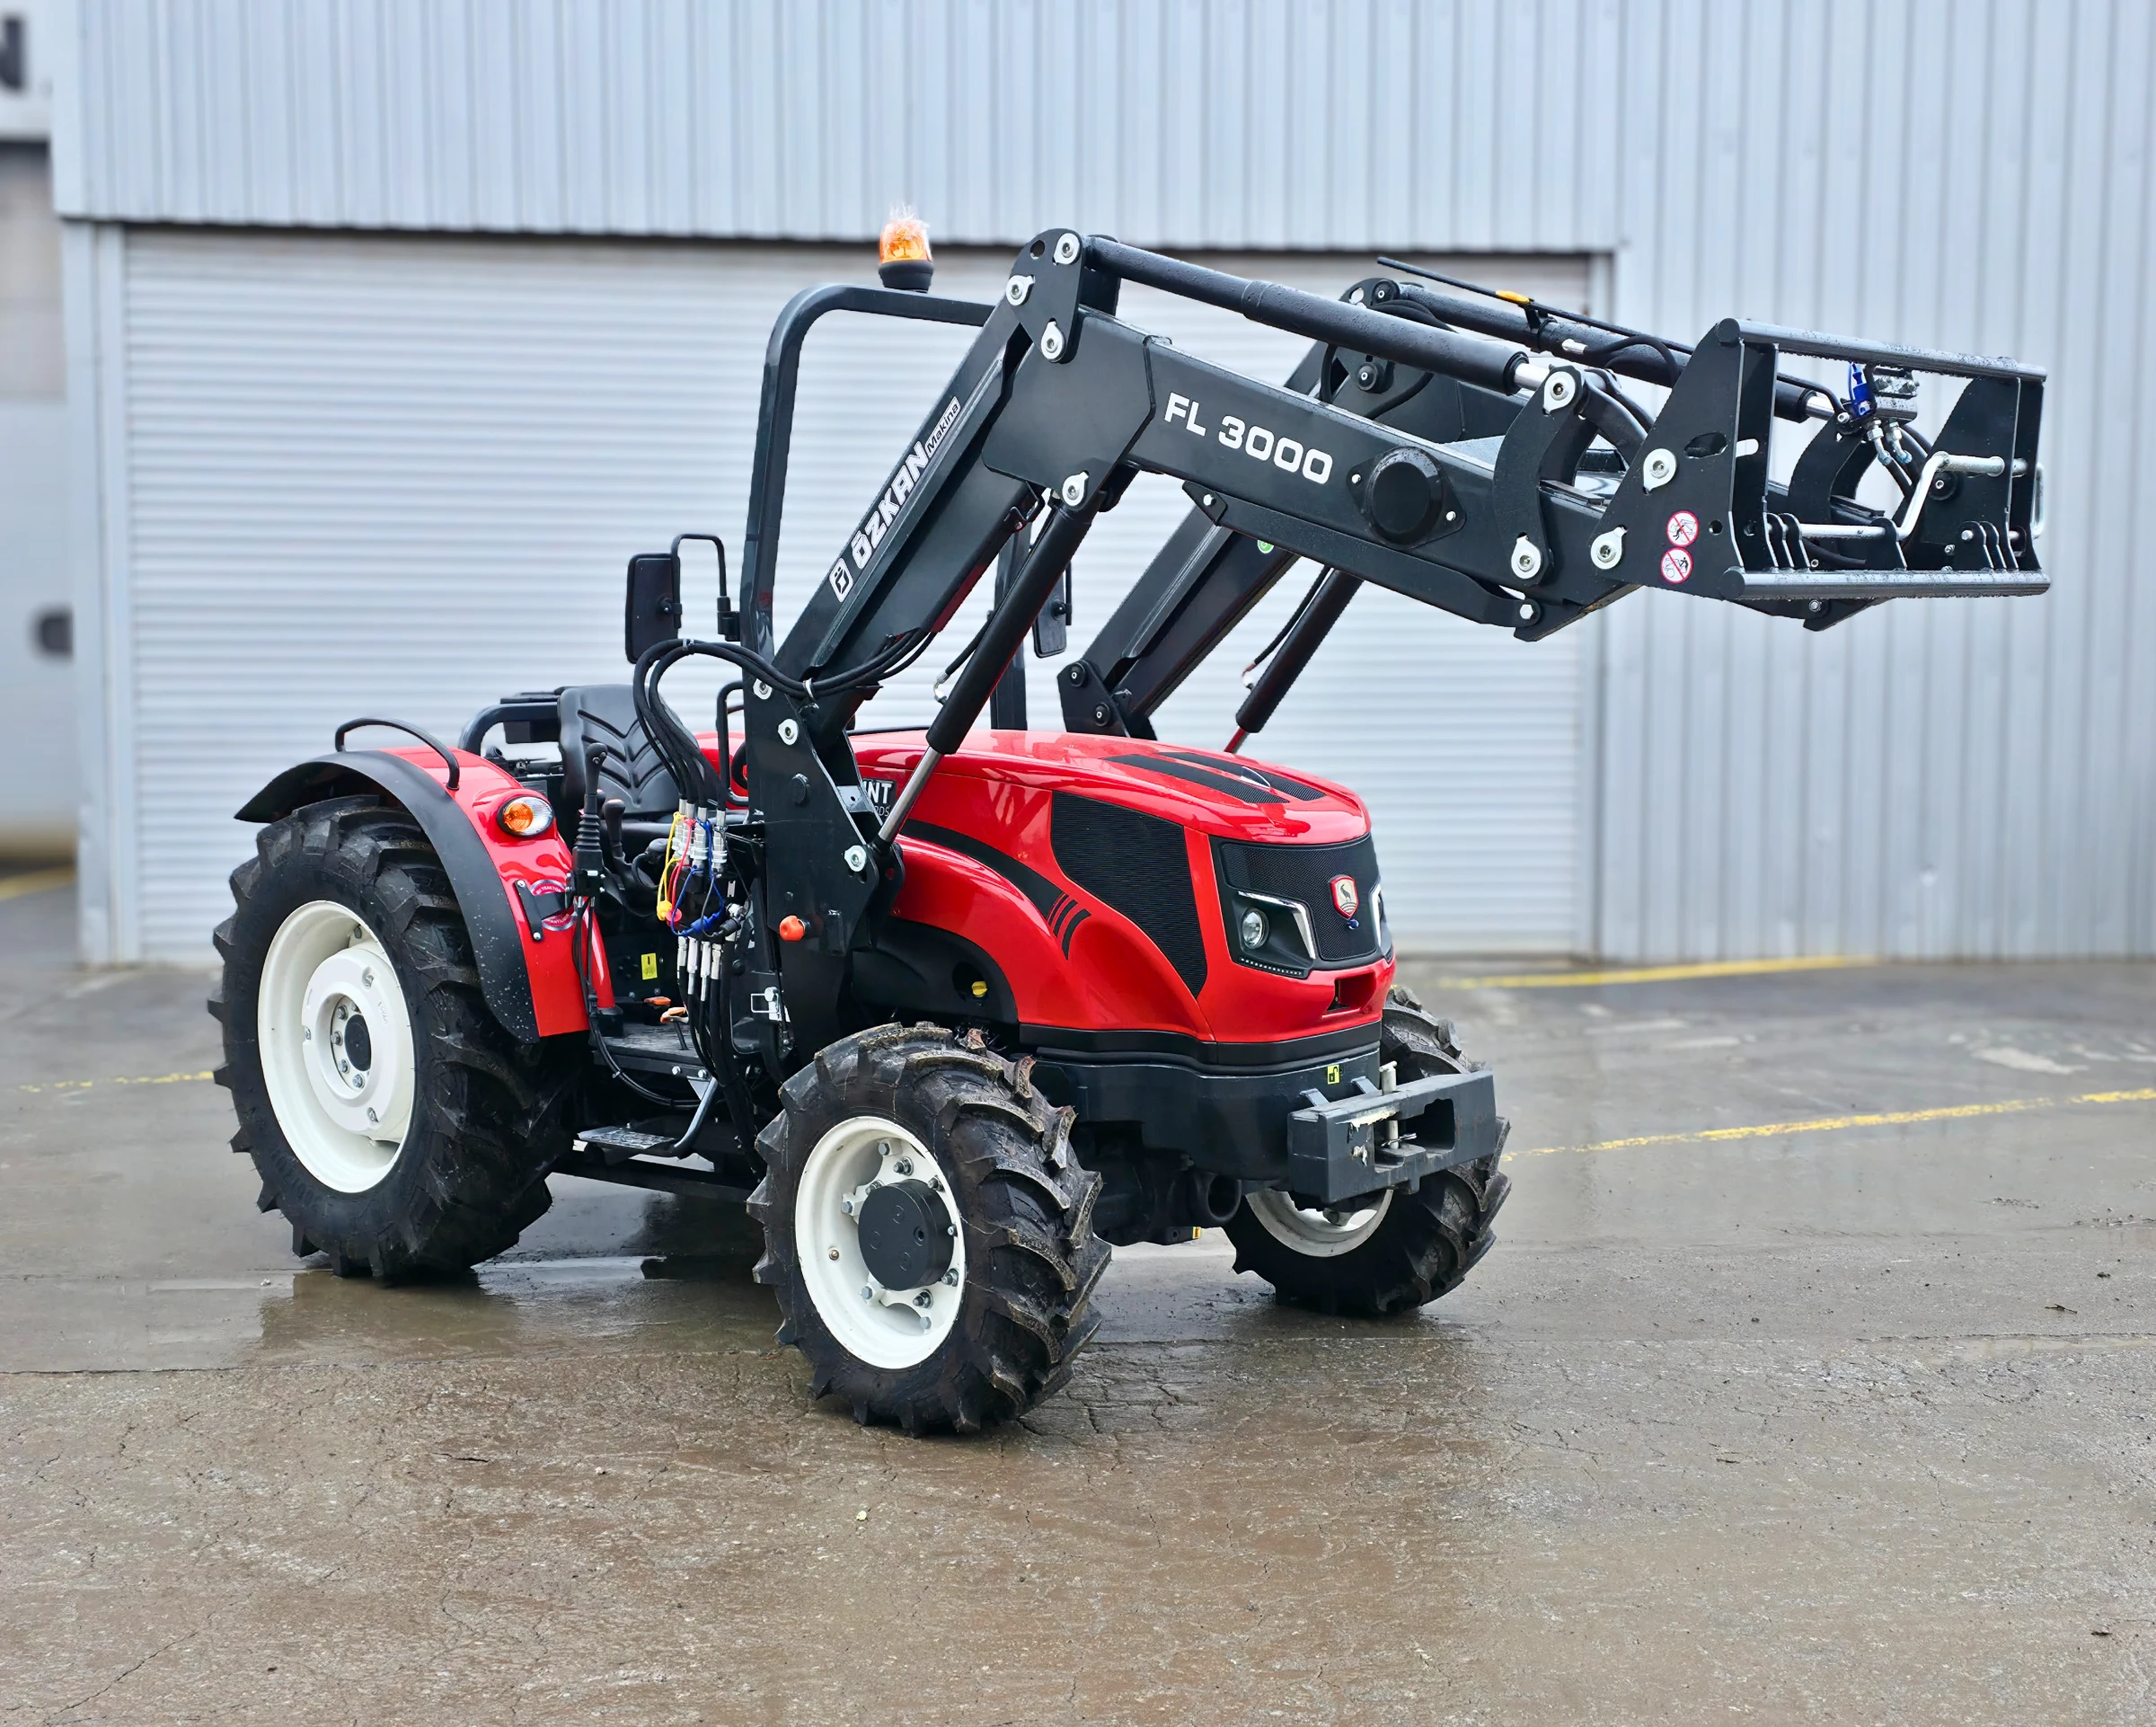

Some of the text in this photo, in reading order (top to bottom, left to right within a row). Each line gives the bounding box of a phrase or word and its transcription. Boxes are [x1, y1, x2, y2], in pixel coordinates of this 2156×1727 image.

[927, 403, 959, 453] Makina
[1164, 392, 1333, 484] FL 3000
